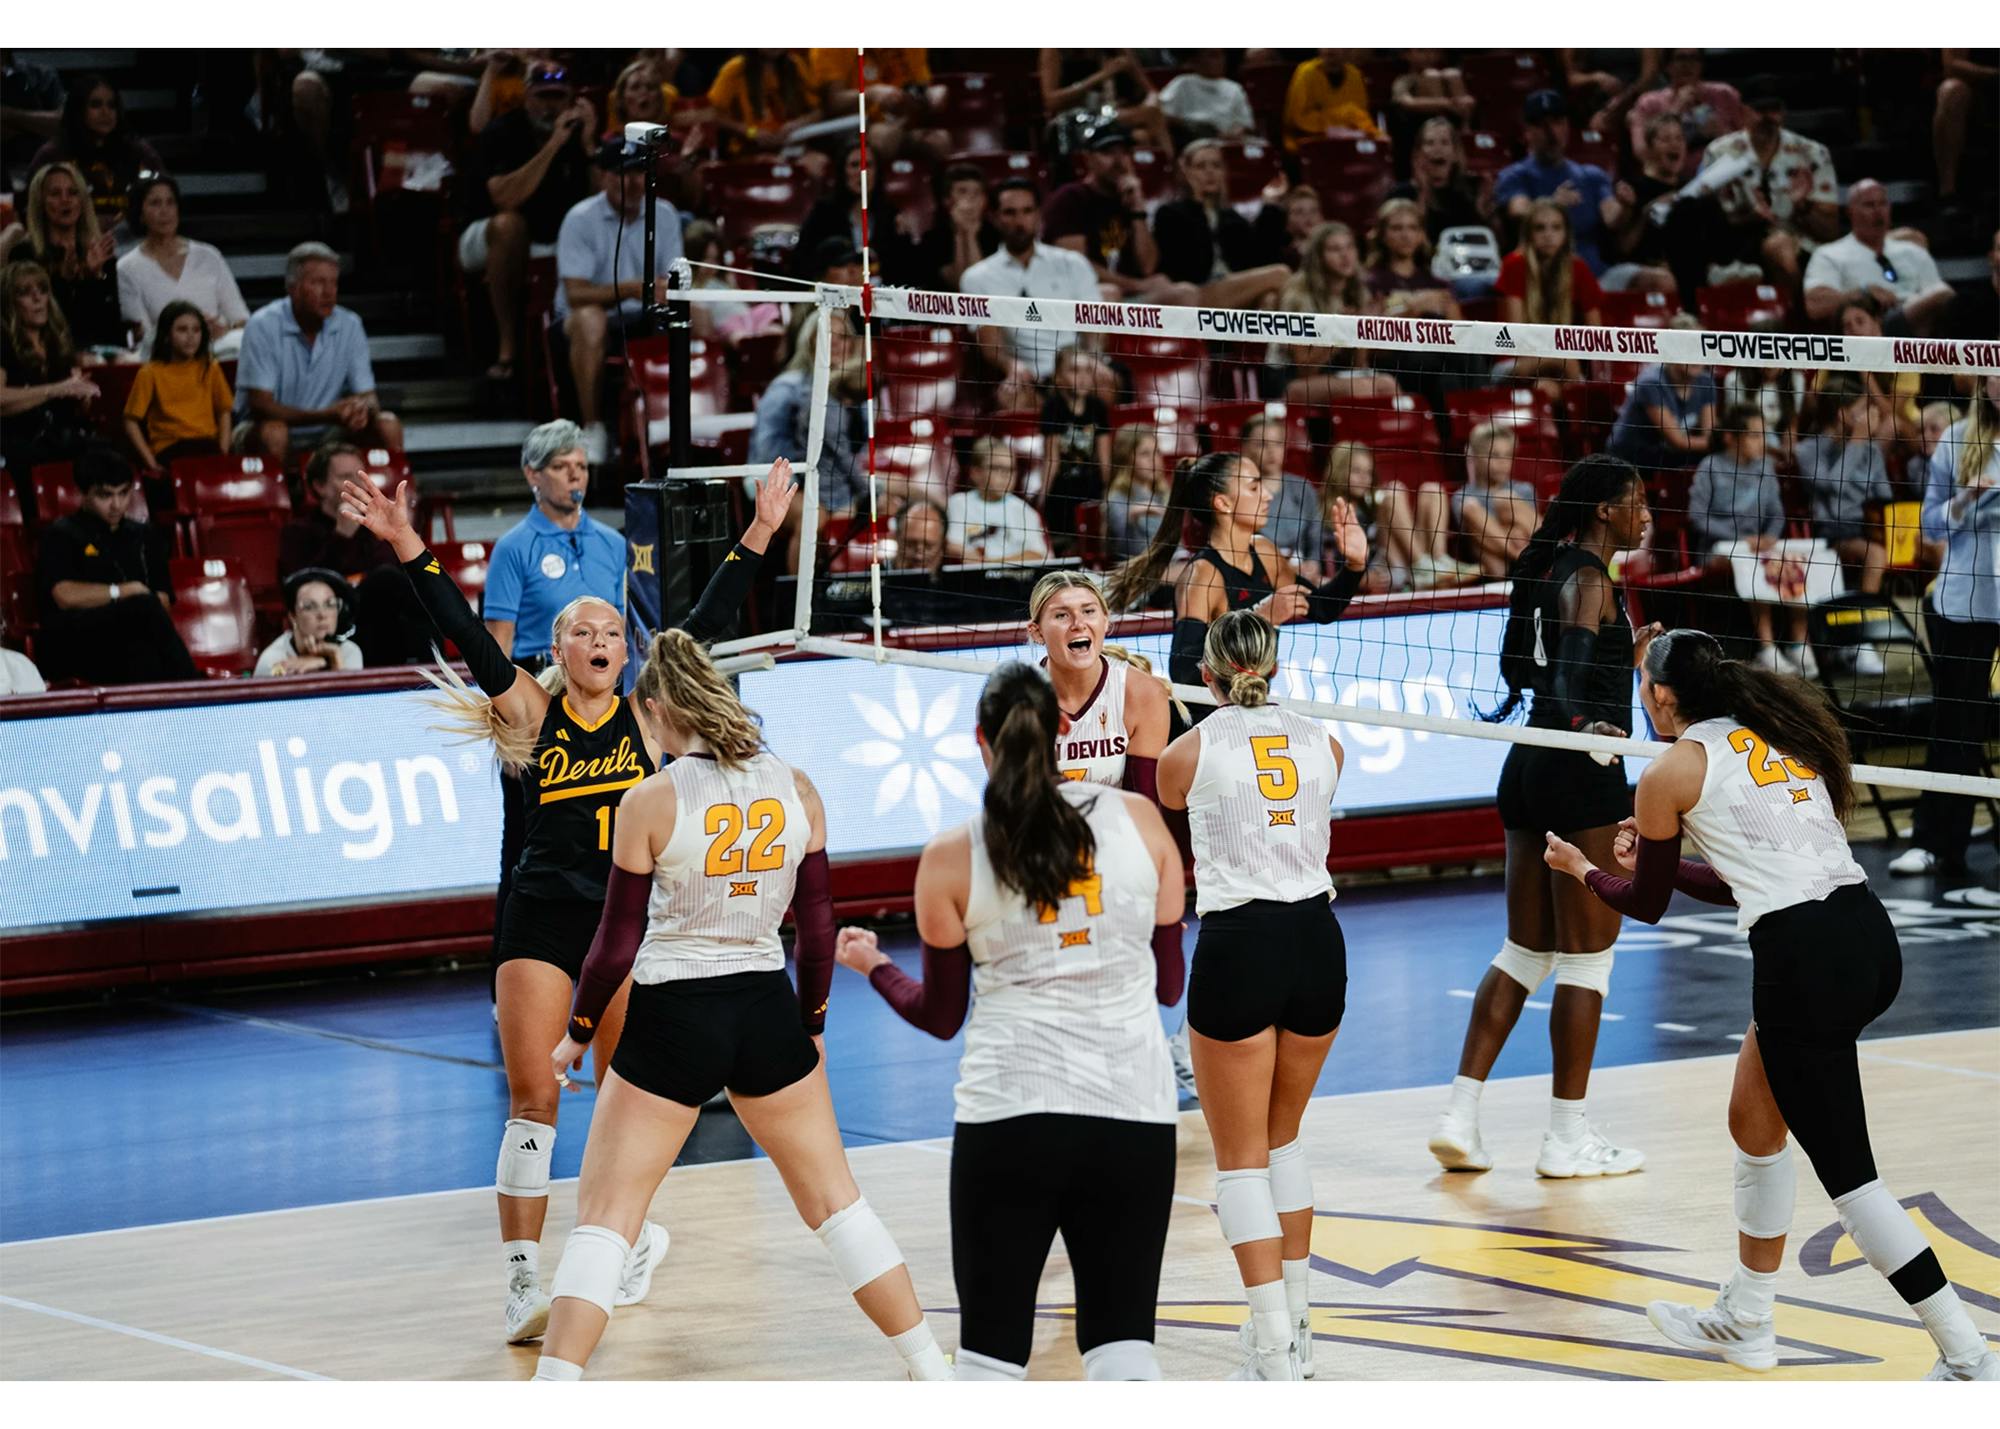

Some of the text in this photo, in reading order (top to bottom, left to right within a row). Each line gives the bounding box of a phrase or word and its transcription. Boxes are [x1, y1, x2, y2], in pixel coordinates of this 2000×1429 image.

[907, 292, 991, 318] ARIZONA STATE
[1074, 303, 1163, 329] ARIZONA STATE
[1356, 319, 1456, 345] ARIZONA STATE
[1554, 328, 1660, 354] ARIZONA STATE
[1893, 340, 1961, 365] ARIZONA
[1067, 736, 1125, 760] DEVILS
[539, 736, 645, 788] Devils
[1249, 734, 1299, 801] 5
[704, 797, 786, 877] 22
